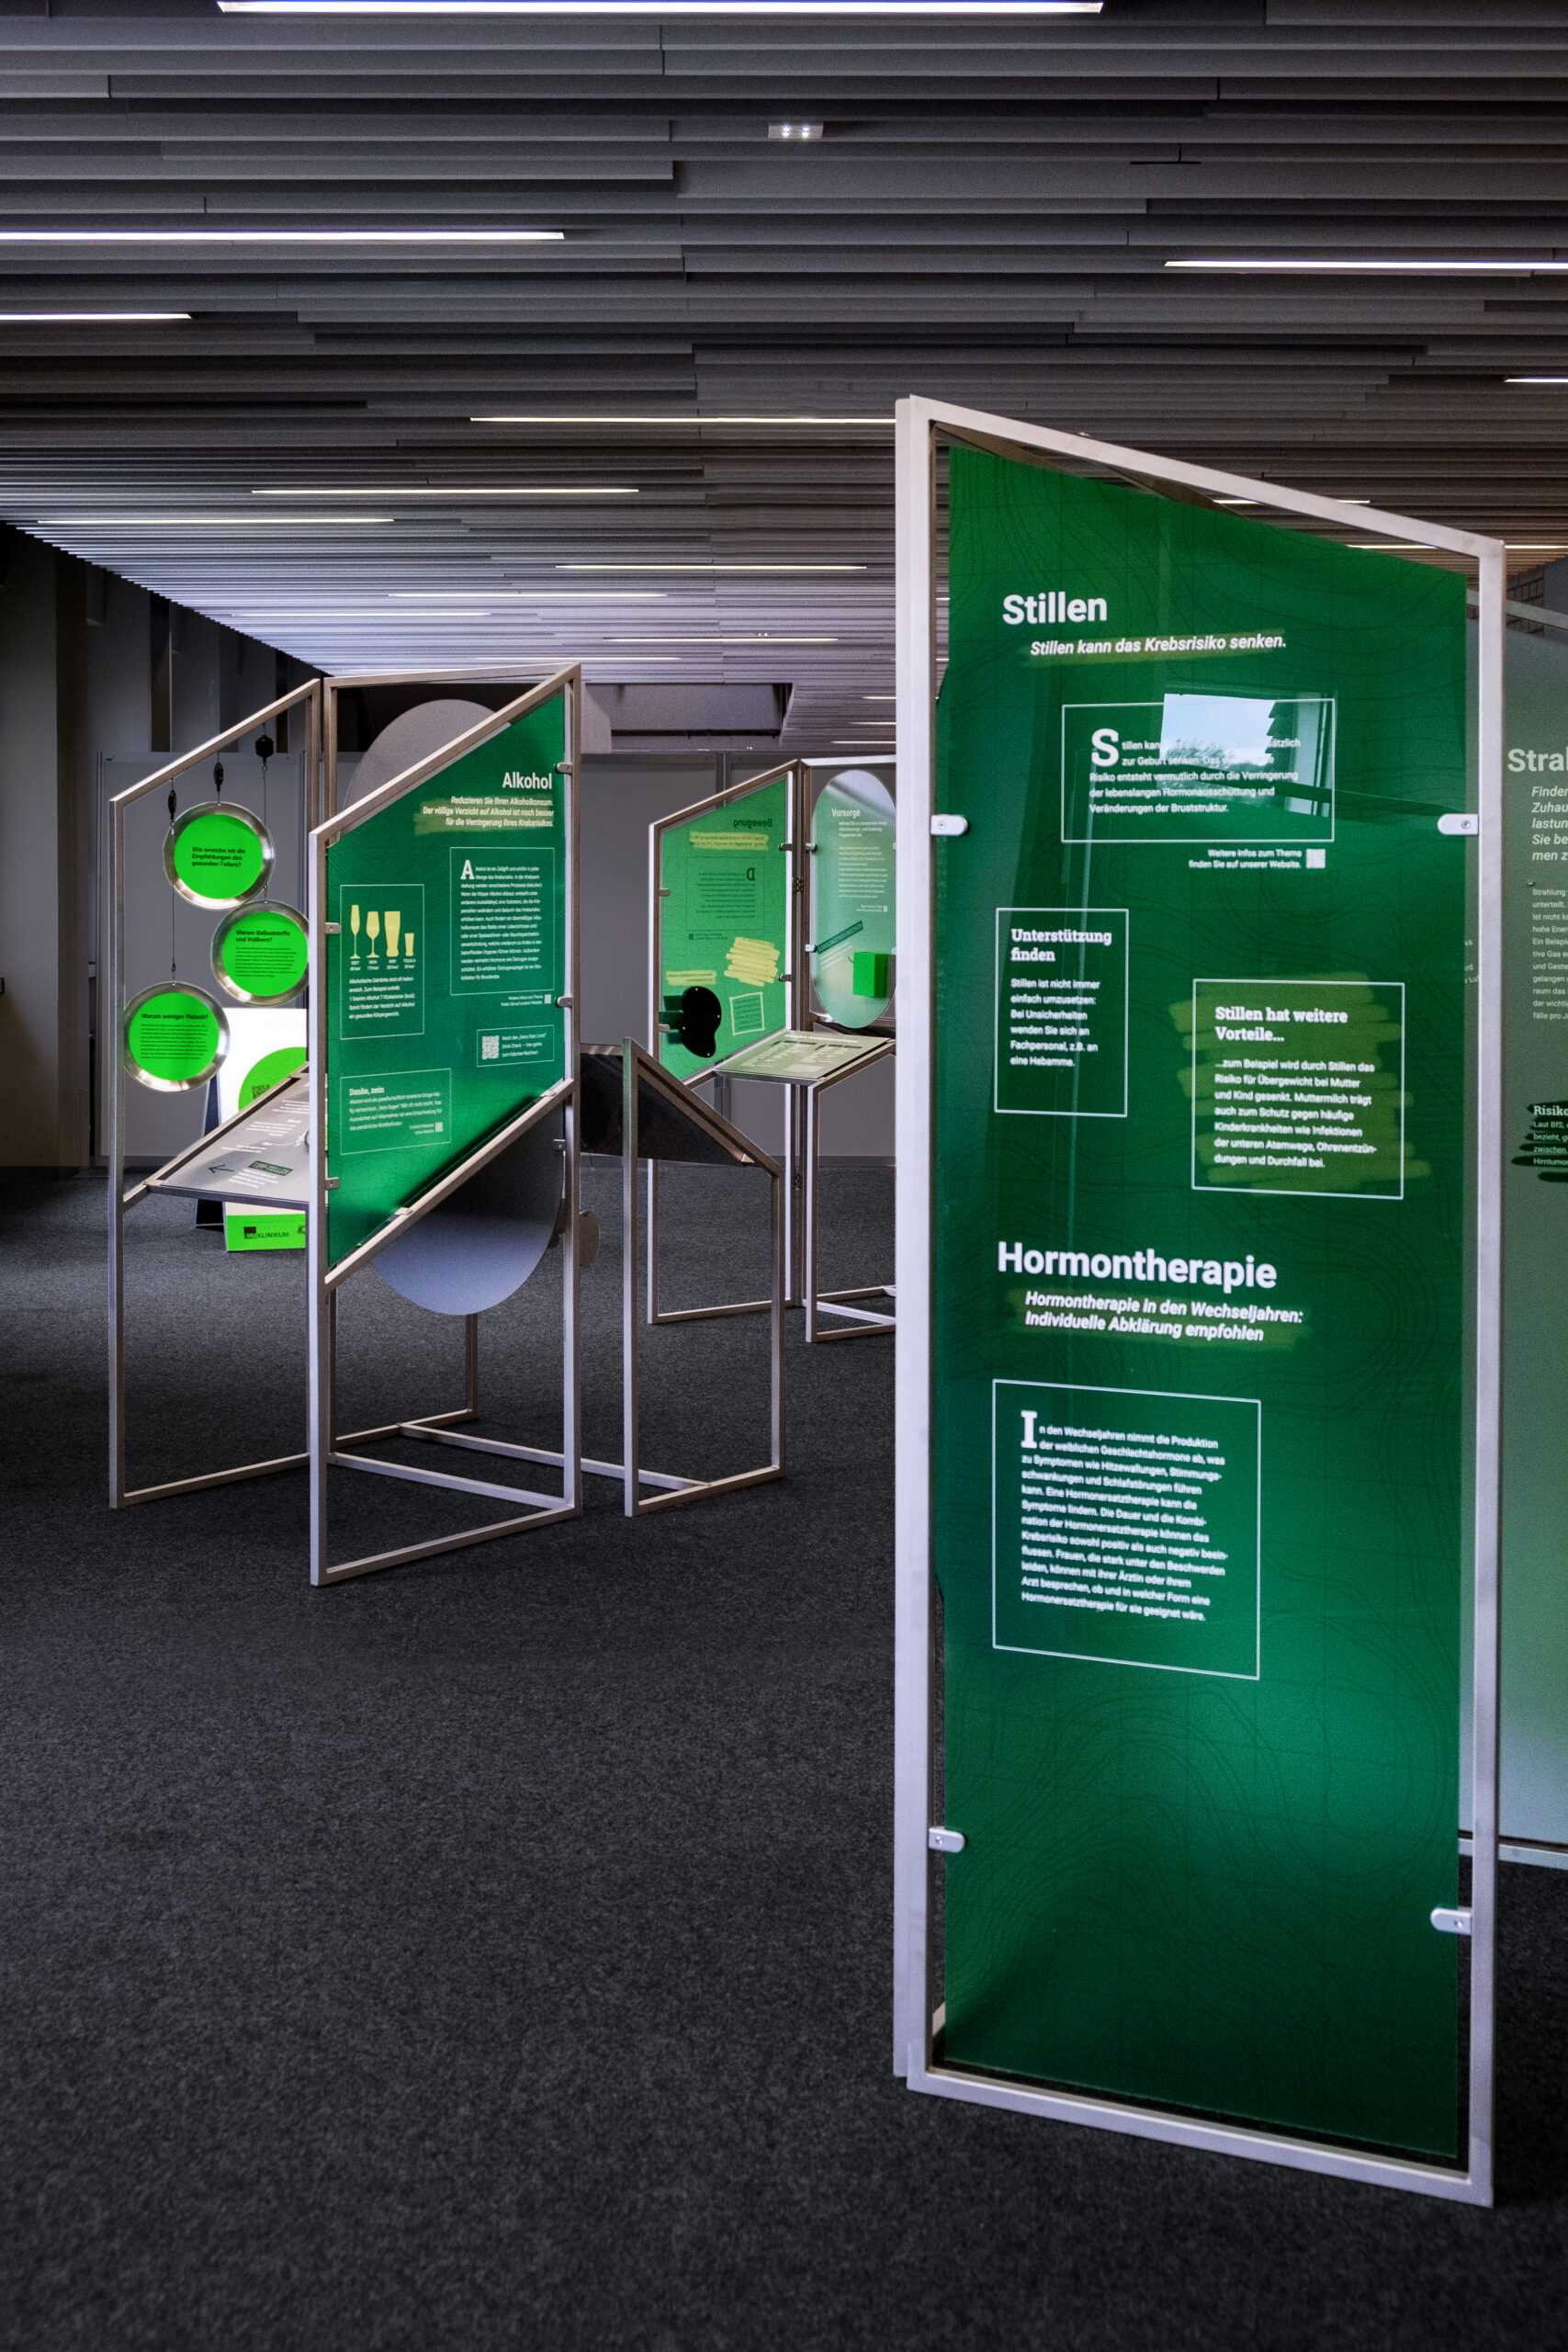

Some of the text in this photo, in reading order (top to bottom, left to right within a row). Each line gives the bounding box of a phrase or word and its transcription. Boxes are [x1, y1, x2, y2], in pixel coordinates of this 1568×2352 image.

[1002, 591, 1107, 625] Stillen
[1031, 633, 1286, 655] Stillen kann das Krebsrisiko senken.
[1137, 755, 1168, 765] Geburt
[502, 772, 552, 789] Alkohol
[1089, 770, 1299, 782] Risiko entsteht vermutlich durch die Verringerung
[1089, 786, 1275, 798] der lebenslangen Hormonausschüttung und
[831, 808, 861, 819] Vorsorge
[1089, 803, 1229, 814] Veränderungen der Bruststruktur.
[1189, 860, 1213, 868] finden
[1213, 860, 1225, 868] Sie
[1225, 860, 1239, 868] auf
[1269, 860, 1302, 868] Website.
[1532, 888, 1566, 897] Strahlung
[1010, 928, 1111, 946] Unterstützung
[1010, 947, 1055, 962] finden
[1010, 978, 1100, 989] Stillen ist nicht immer
[1533, 975, 1565, 983] gelangen
[1010, 994, 1096, 1005] einfach umzusetzen:
[1010, 1009, 1088, 1020] Bei Unsicherheiten
[1215, 1006, 1348, 1023] Stillen hat weitere
[1010, 1025, 1043, 1035] wenden
[1044, 1026, 1058, 1035] Sie
[1059, 1026, 1077, 1035] sich
[1214, 1026, 1284, 1042] Vorteile...
[1010, 1040, 1098, 1052] Fachpersonal, z.B. an
[1010, 1057, 1075, 1067] eine Hebamme.
[1243, 1058, 1279, 1070] Beispiel
[1280, 1060, 1300, 1069] wird
[1301, 1060, 1326, 1070] durch
[1328, 1061, 1357, 1071] Stillen
[1358, 1062, 1375, 1072] das
[1214, 1073, 1360, 1088] Risiko für Übergewicht bei Mutter
[1214, 1091, 1372, 1107] und Kind gesenkt. Muttermilch trägt
[1214, 1106, 1354, 1122] auch zum Schutz gegen häufige
[1214, 1122, 1362, 1136] Kinderkrankheiten wie Infektionen
[1213, 1137, 1377, 1154] der unteren Atemwege, Ohrenentzün-
[1213, 1154, 1325, 1168] dungen und Durchfall bei.
[998, 1241, 1277, 1294] Hormontherapie
[1025, 1291, 1303, 1323] Hormontherapie in den Wechseljahren:
[1025, 1310, 1264, 1341] Individuelle Abklärung empfohlen
[1046, 1426, 1063, 1435] den
[1064, 1427, 1126, 1441] Wechseljahren
[1126, 1433, 1155, 1443] nimmt
[1156, 1434, 1170, 1445] die
[1171, 1435, 1218, 1449] Produktion
